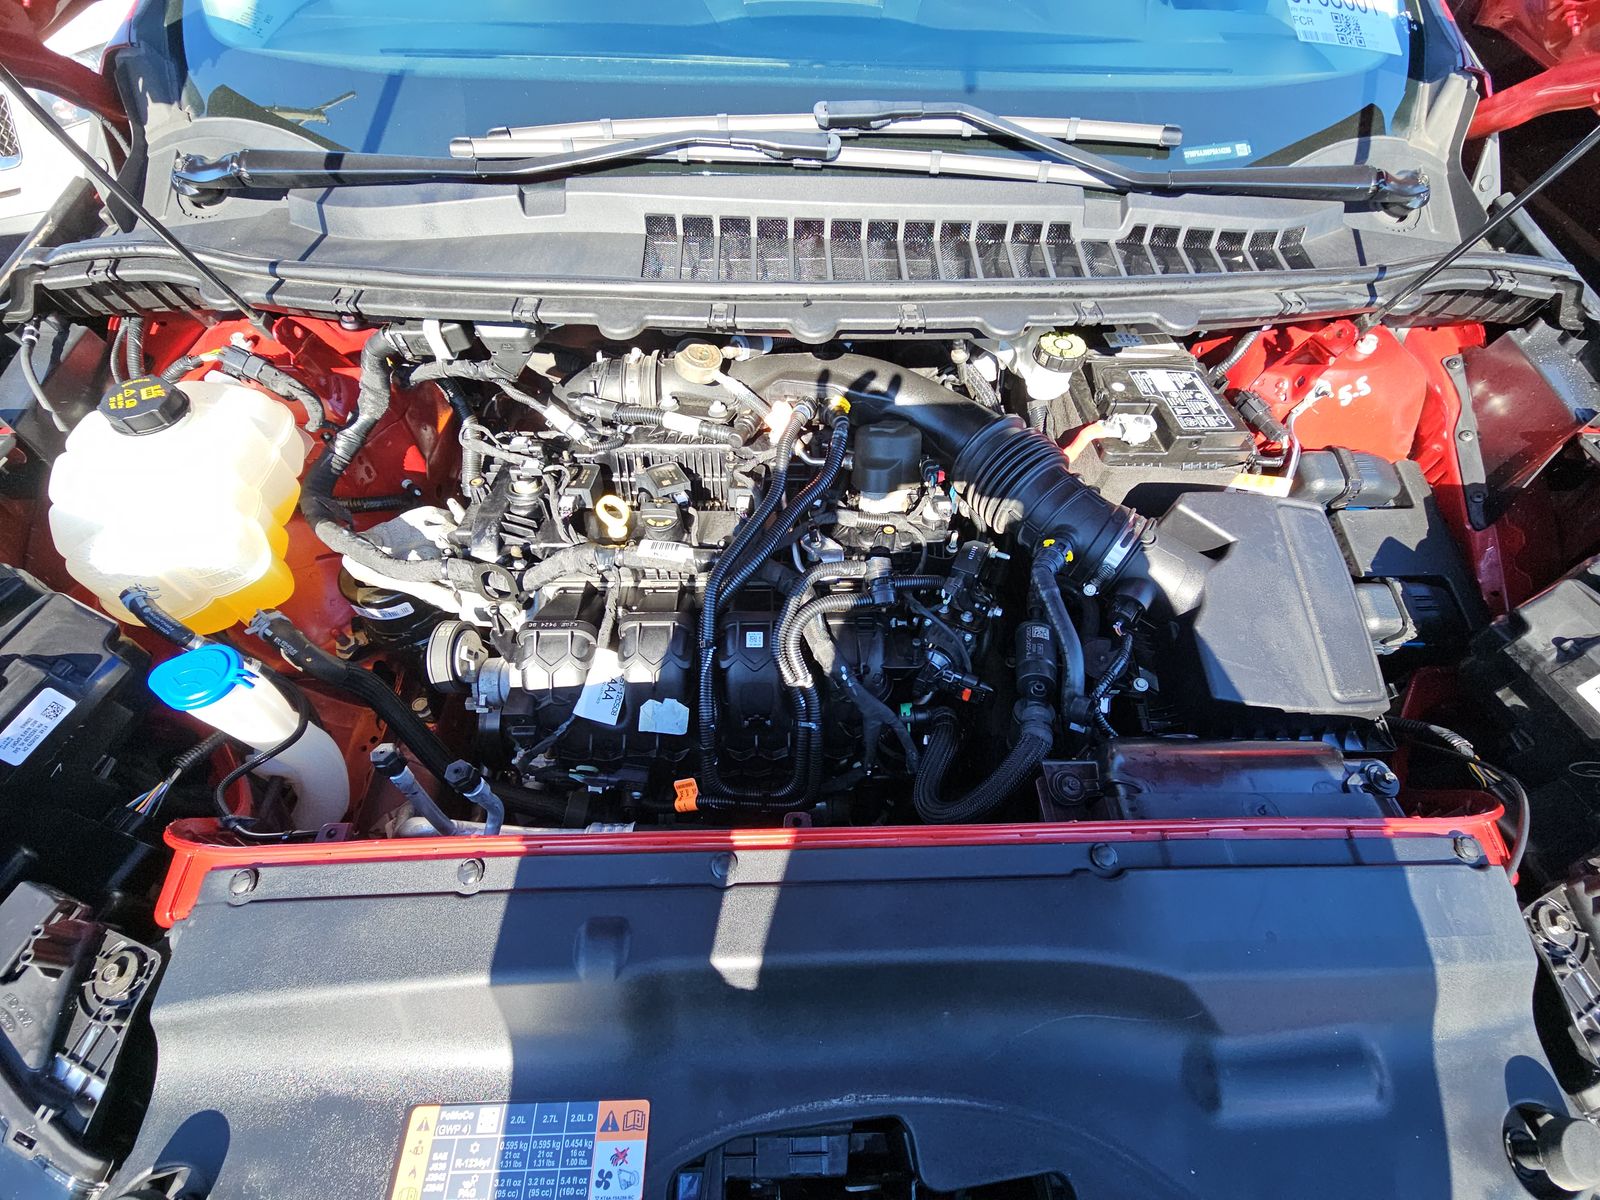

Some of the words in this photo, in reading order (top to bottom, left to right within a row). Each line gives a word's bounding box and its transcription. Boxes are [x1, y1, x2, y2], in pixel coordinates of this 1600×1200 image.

[1293, 15, 1315, 26] FCR
[602, 677, 619, 700] AAA
[510, 1115, 526, 1124] 2.0L
[542, 1115, 558, 1124] 2.7L
[570, 1114, 586, 1122] 2.0L
[500, 1141, 518, 1150] 0.595
[519, 1140, 528, 1151] kg
[532, 1140, 550, 1149] 0.595
[552, 1140, 560, 1150] kg
[565, 1139, 583, 1148] 0.454
[584, 1139, 593, 1149] kg
[504, 1151, 511, 1159] 21
[494, 1178, 504, 1187] 3.2
[528, 1178, 538, 1186] 3.2
[560, 1177, 571, 1185] 5.4
[495, 1190, 506, 1199] (95
[507, 1190, 519, 1198] cc)
[528, 1189, 540, 1198] (95
[541, 1189, 552, 1197] cc)
[560, 1189, 574, 1197] (160
[575, 1188, 587, 1196] cc)
